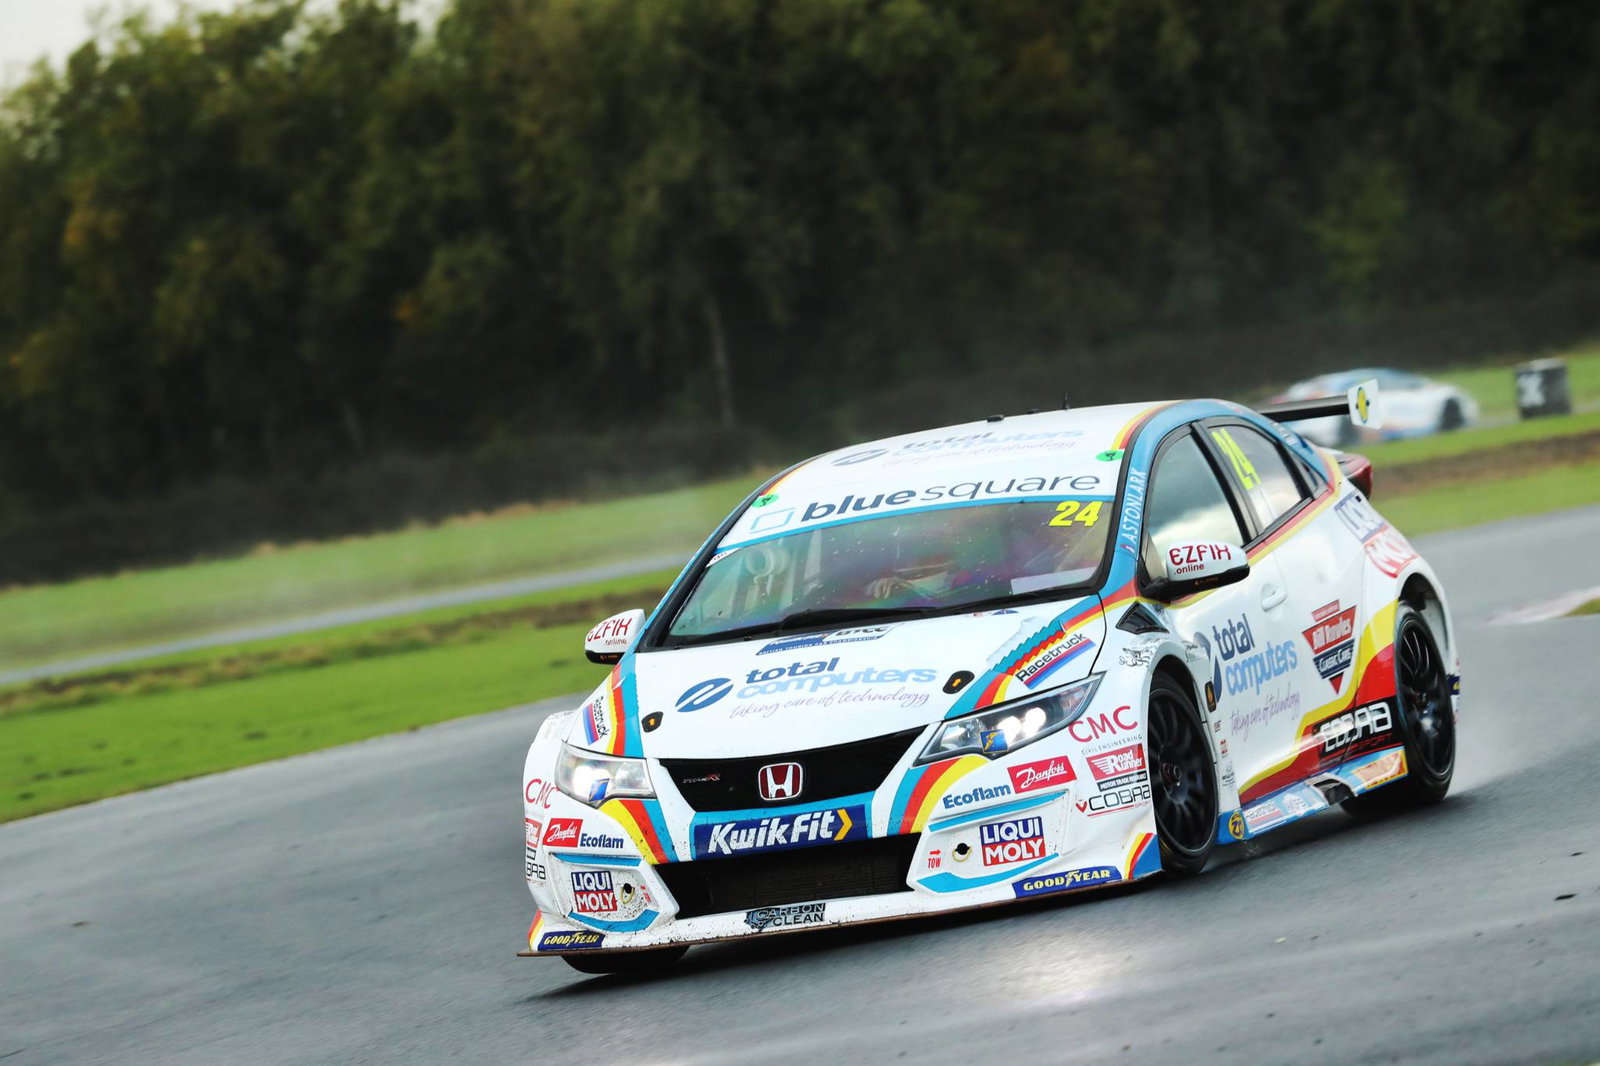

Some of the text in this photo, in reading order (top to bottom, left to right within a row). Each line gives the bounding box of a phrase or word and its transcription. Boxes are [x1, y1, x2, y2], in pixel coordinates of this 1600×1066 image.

[1047, 500, 1104, 528] 24
[1212, 612, 1256, 661] total
[745, 657, 841, 684] total
[1014, 632, 1087, 682] Racetruck
[1225, 640, 1298, 696] computers
[736, 667, 938, 700] computers
[730, 702, 780, 719] taking
[783, 696, 818, 708] care
[837, 686, 931, 708] technology
[1068, 705, 1138, 743] CMC
[1015, 759, 1069, 789] Danfoss
[525, 778, 561, 809] CMC
[942, 784, 1012, 810] Ecoflam
[1088, 784, 1151, 811] COBRA
[579, 832, 624, 849] Ecoflam
[981, 817, 1041, 844] LIQUI
[927, 857, 942, 869] TOW
[984, 837, 1045, 866] MOLY
[572, 872, 611, 892] LIQUI
[575, 891, 618, 912] MOLY
[757, 903, 826, 919] CARBON
[772, 912, 824, 927] CLEAN
